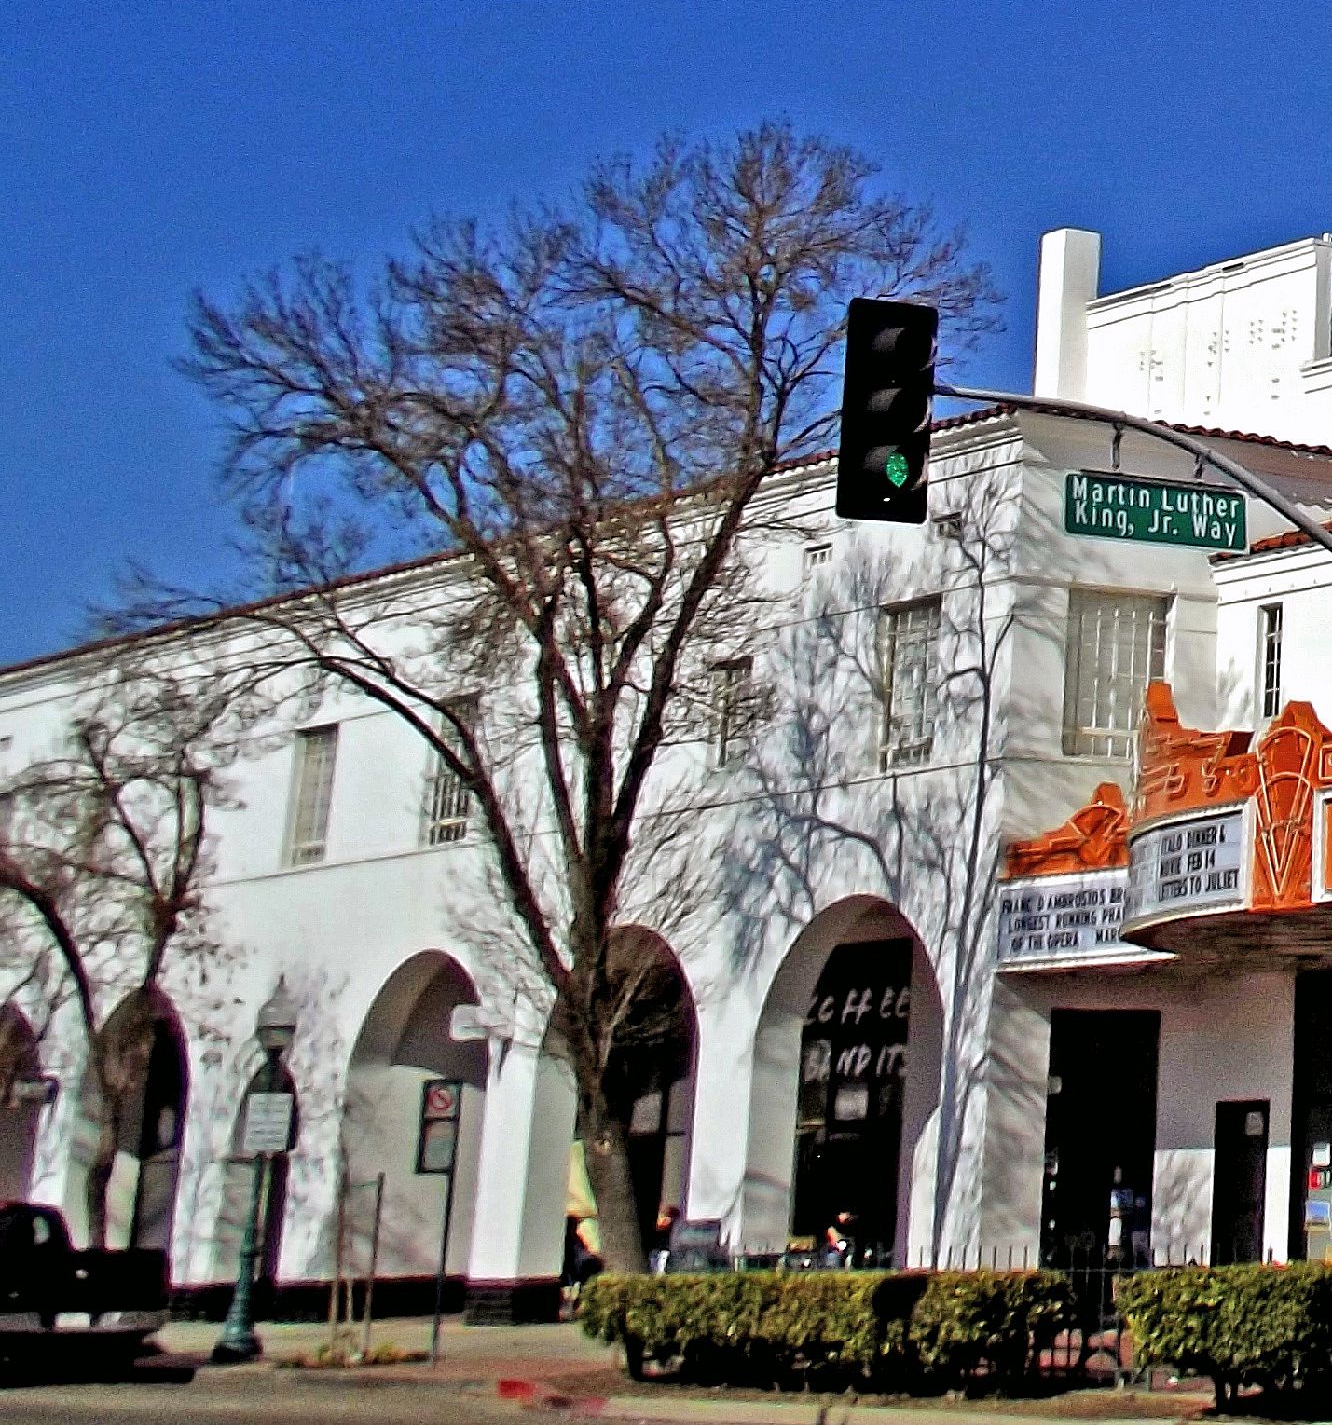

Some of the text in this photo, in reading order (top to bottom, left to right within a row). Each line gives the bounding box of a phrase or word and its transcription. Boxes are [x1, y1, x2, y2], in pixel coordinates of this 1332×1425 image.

[1073, 475, 1240, 519] Martin Luther
[1075, 500, 1236, 548] King, Jr. Way
[1205, 868, 1239, 892] JULIET
